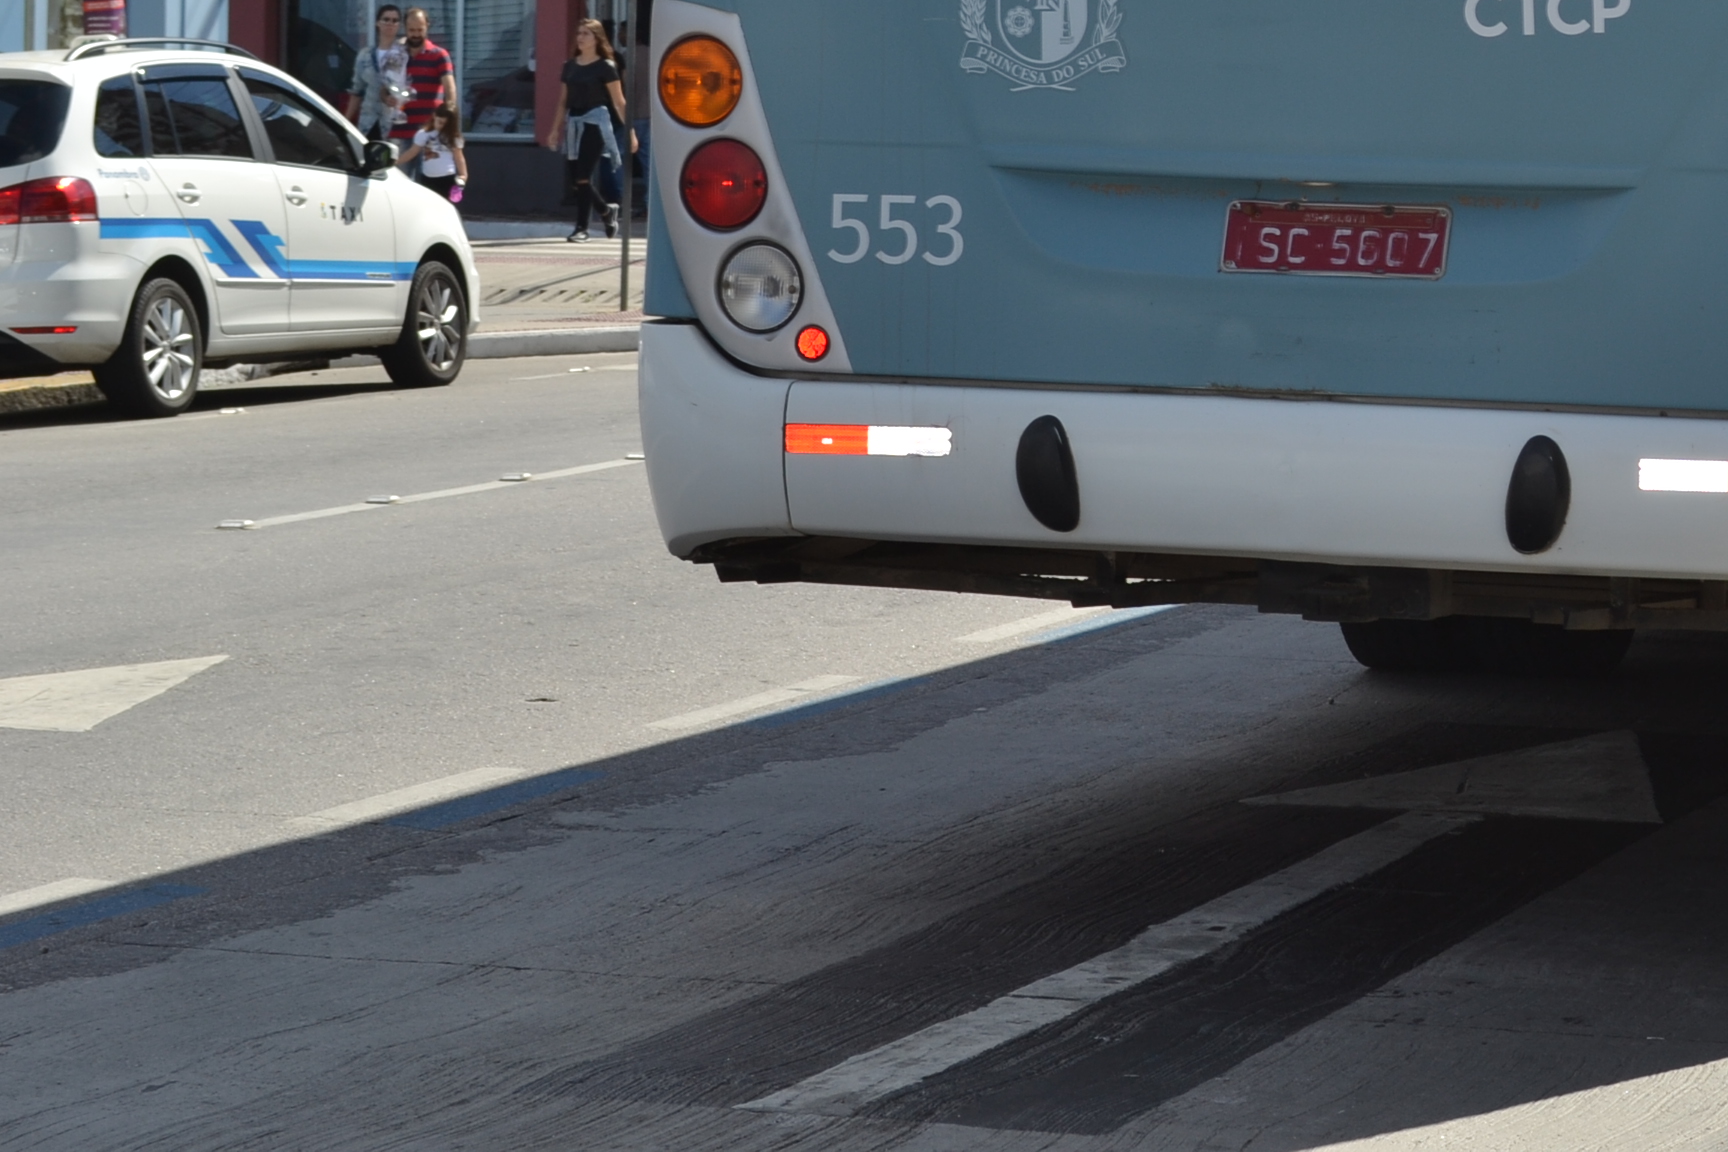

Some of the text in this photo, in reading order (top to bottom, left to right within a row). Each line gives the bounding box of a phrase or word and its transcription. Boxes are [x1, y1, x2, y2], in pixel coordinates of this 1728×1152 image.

[975, 45, 1107, 84] PRINCESA DO SUL
[329, 204, 364, 223] TAXI
[827, 193, 965, 266] 553
